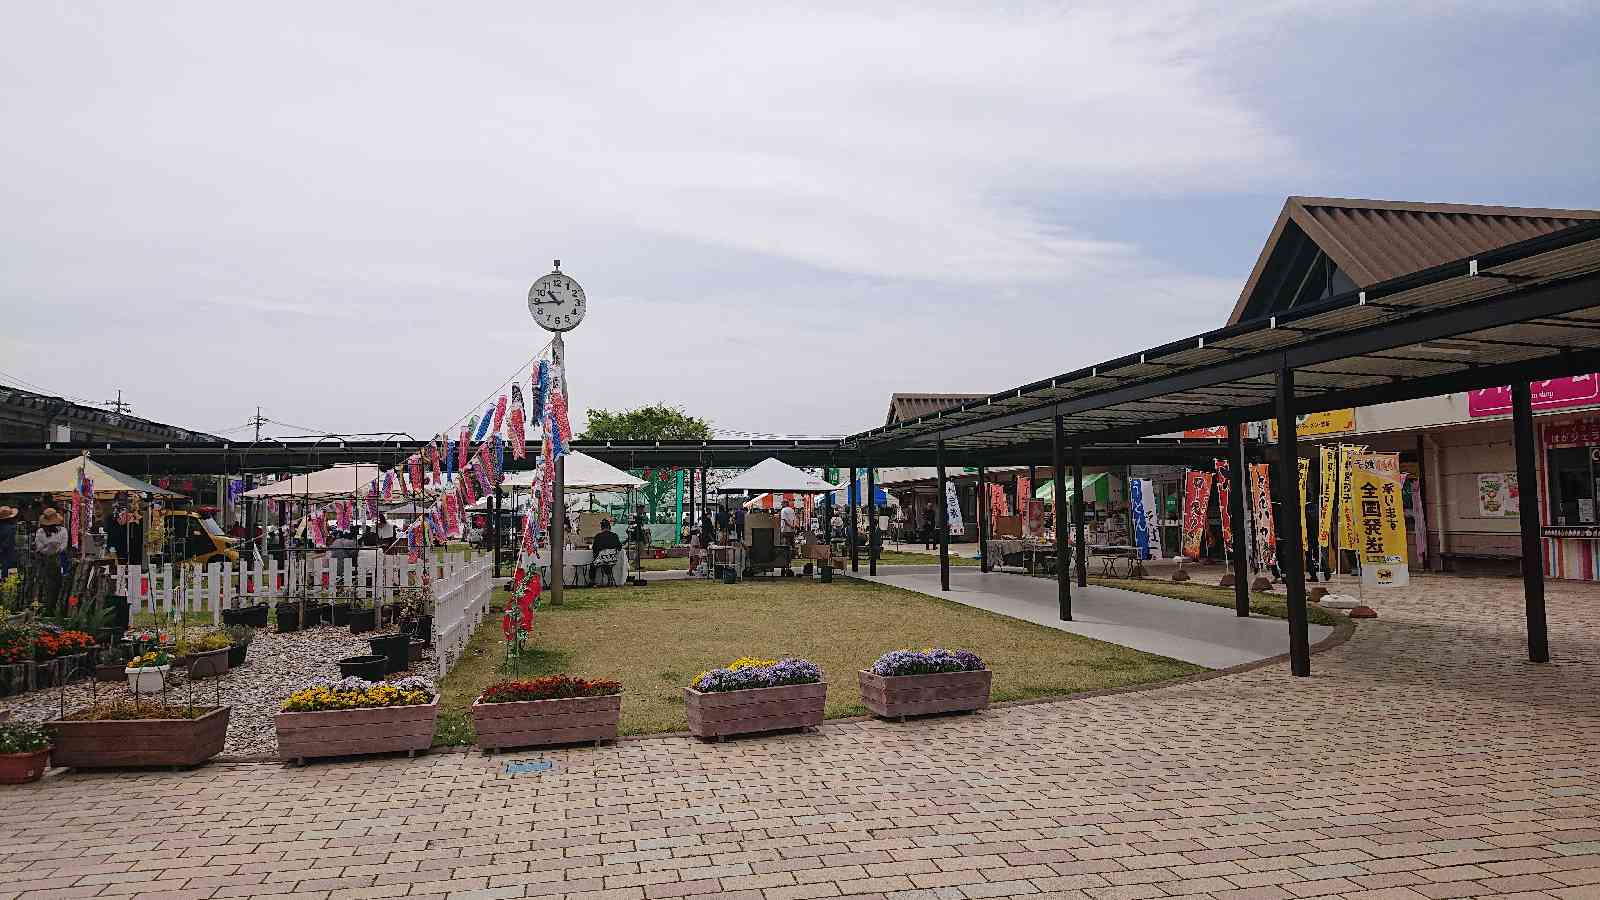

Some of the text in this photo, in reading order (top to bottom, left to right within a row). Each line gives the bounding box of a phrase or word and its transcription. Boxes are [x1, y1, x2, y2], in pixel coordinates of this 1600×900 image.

[543, 281, 550, 290] 11
[552, 280, 561, 288] 12
[564, 315, 570, 323] 5
[1360, 482, 1385, 554] 全国発送
